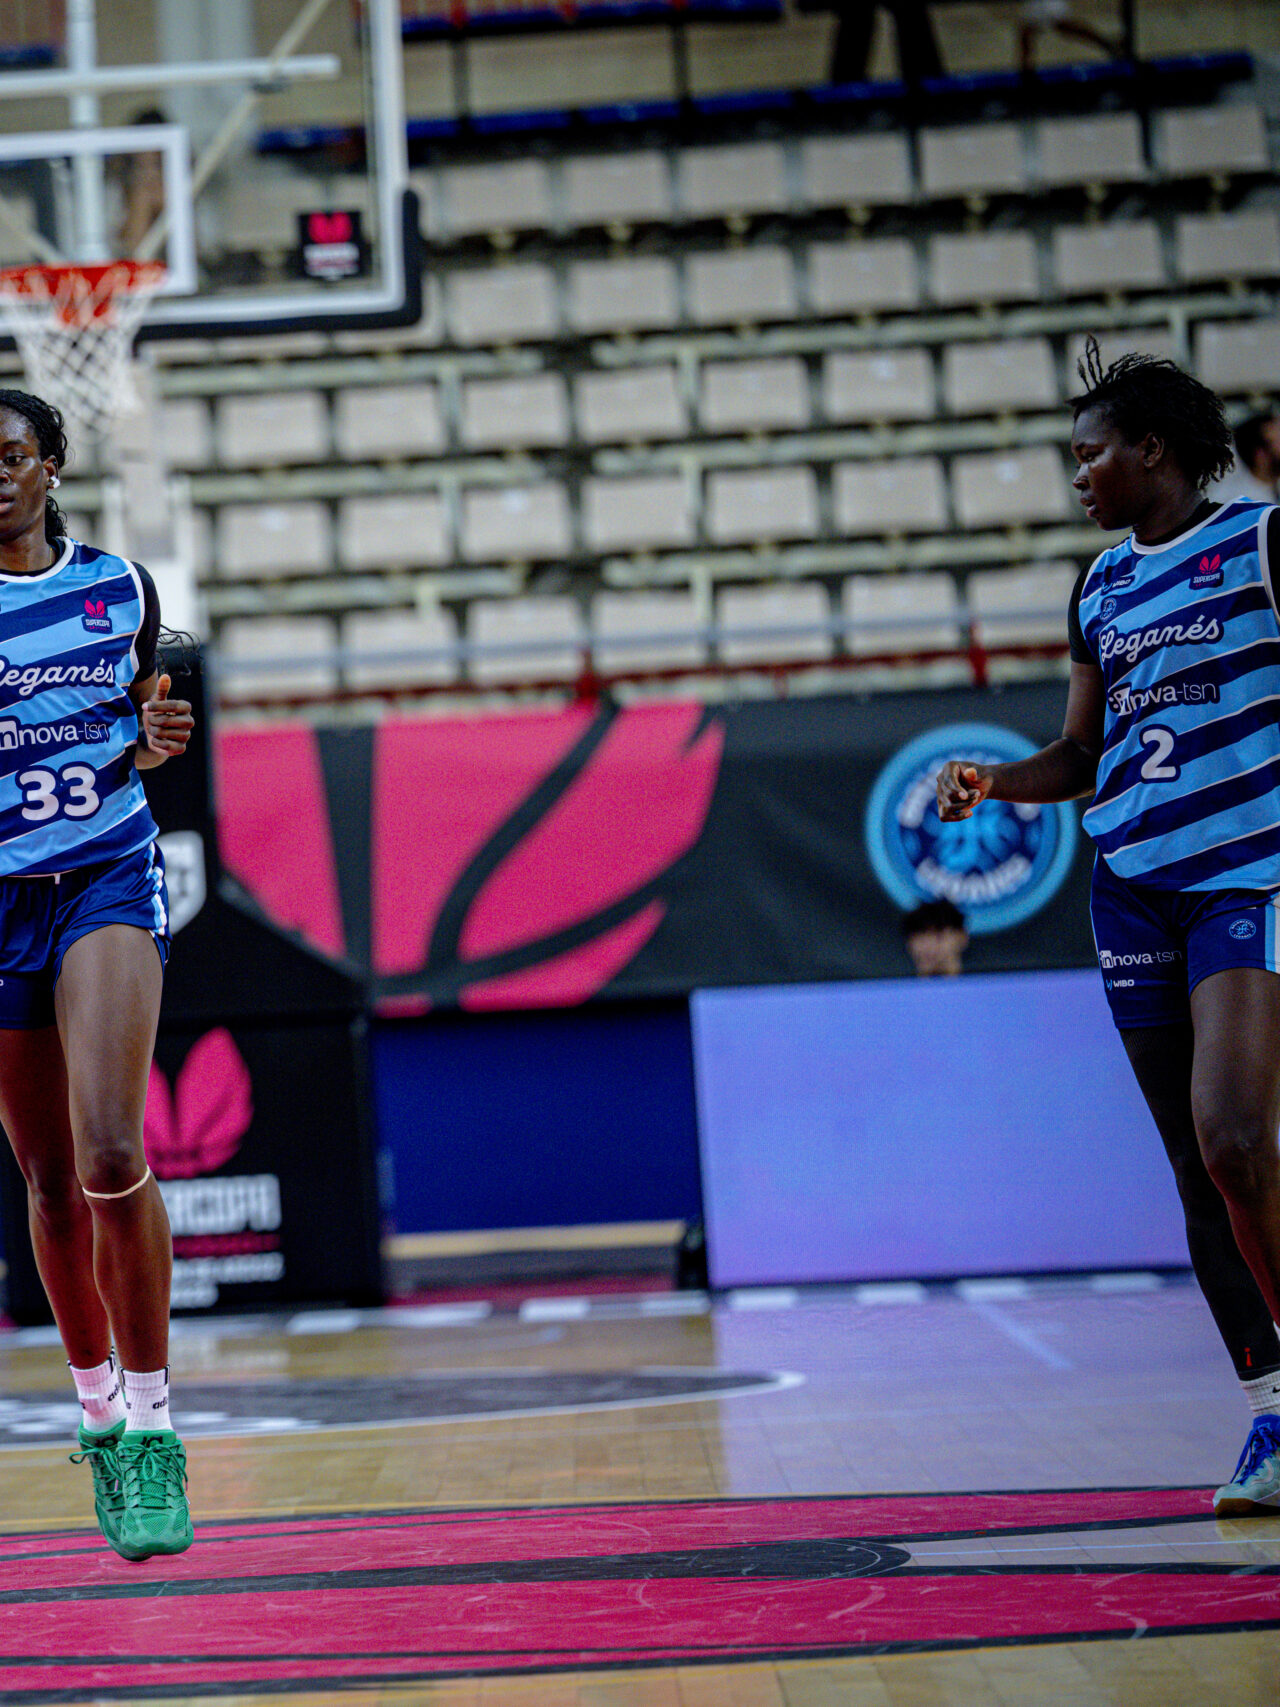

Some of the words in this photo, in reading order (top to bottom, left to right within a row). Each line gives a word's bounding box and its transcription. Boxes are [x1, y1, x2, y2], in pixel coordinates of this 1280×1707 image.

[1100, 614, 1220, 663] Leganés
[1141, 728, 1177, 780] 2
[20, 766, 100, 821] 33
[1113, 979, 1135, 988] WIBO
